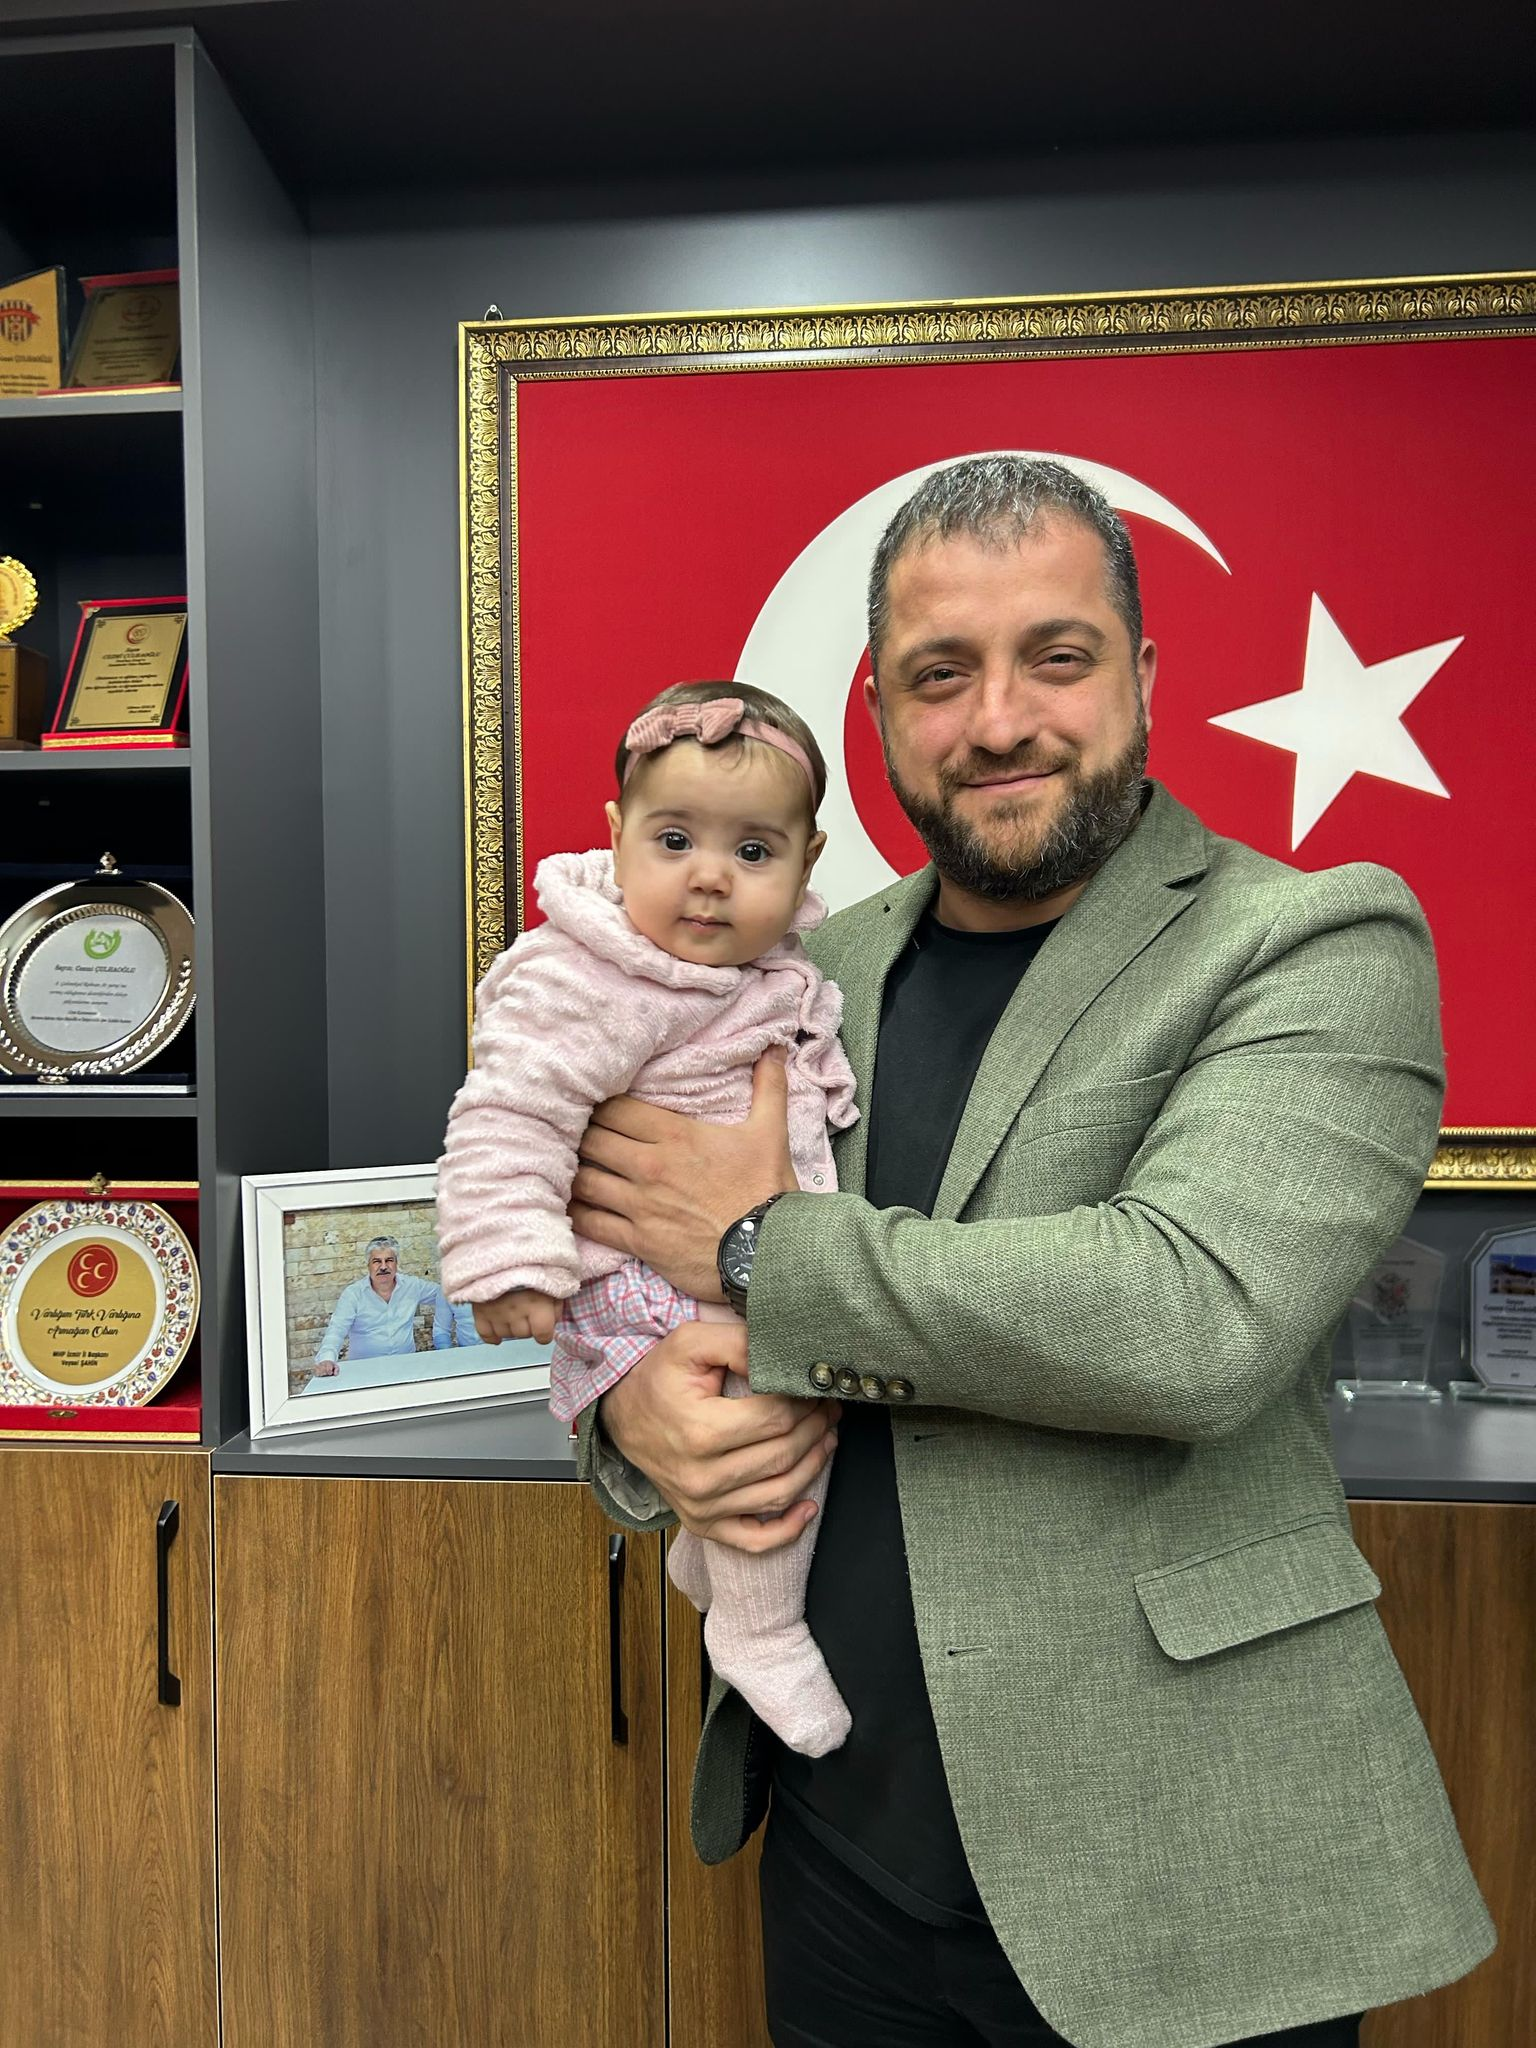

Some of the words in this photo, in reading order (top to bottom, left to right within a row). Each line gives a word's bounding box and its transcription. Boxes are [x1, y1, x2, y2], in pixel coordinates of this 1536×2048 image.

[31, 1308, 72, 1321] Varlığım
[75, 1309, 95, 1321] Türk
[96, 1309, 141, 1322] Varlığına
[47, 1325, 89, 1338] Armağan
[92, 1326, 119, 1338] Olsun
